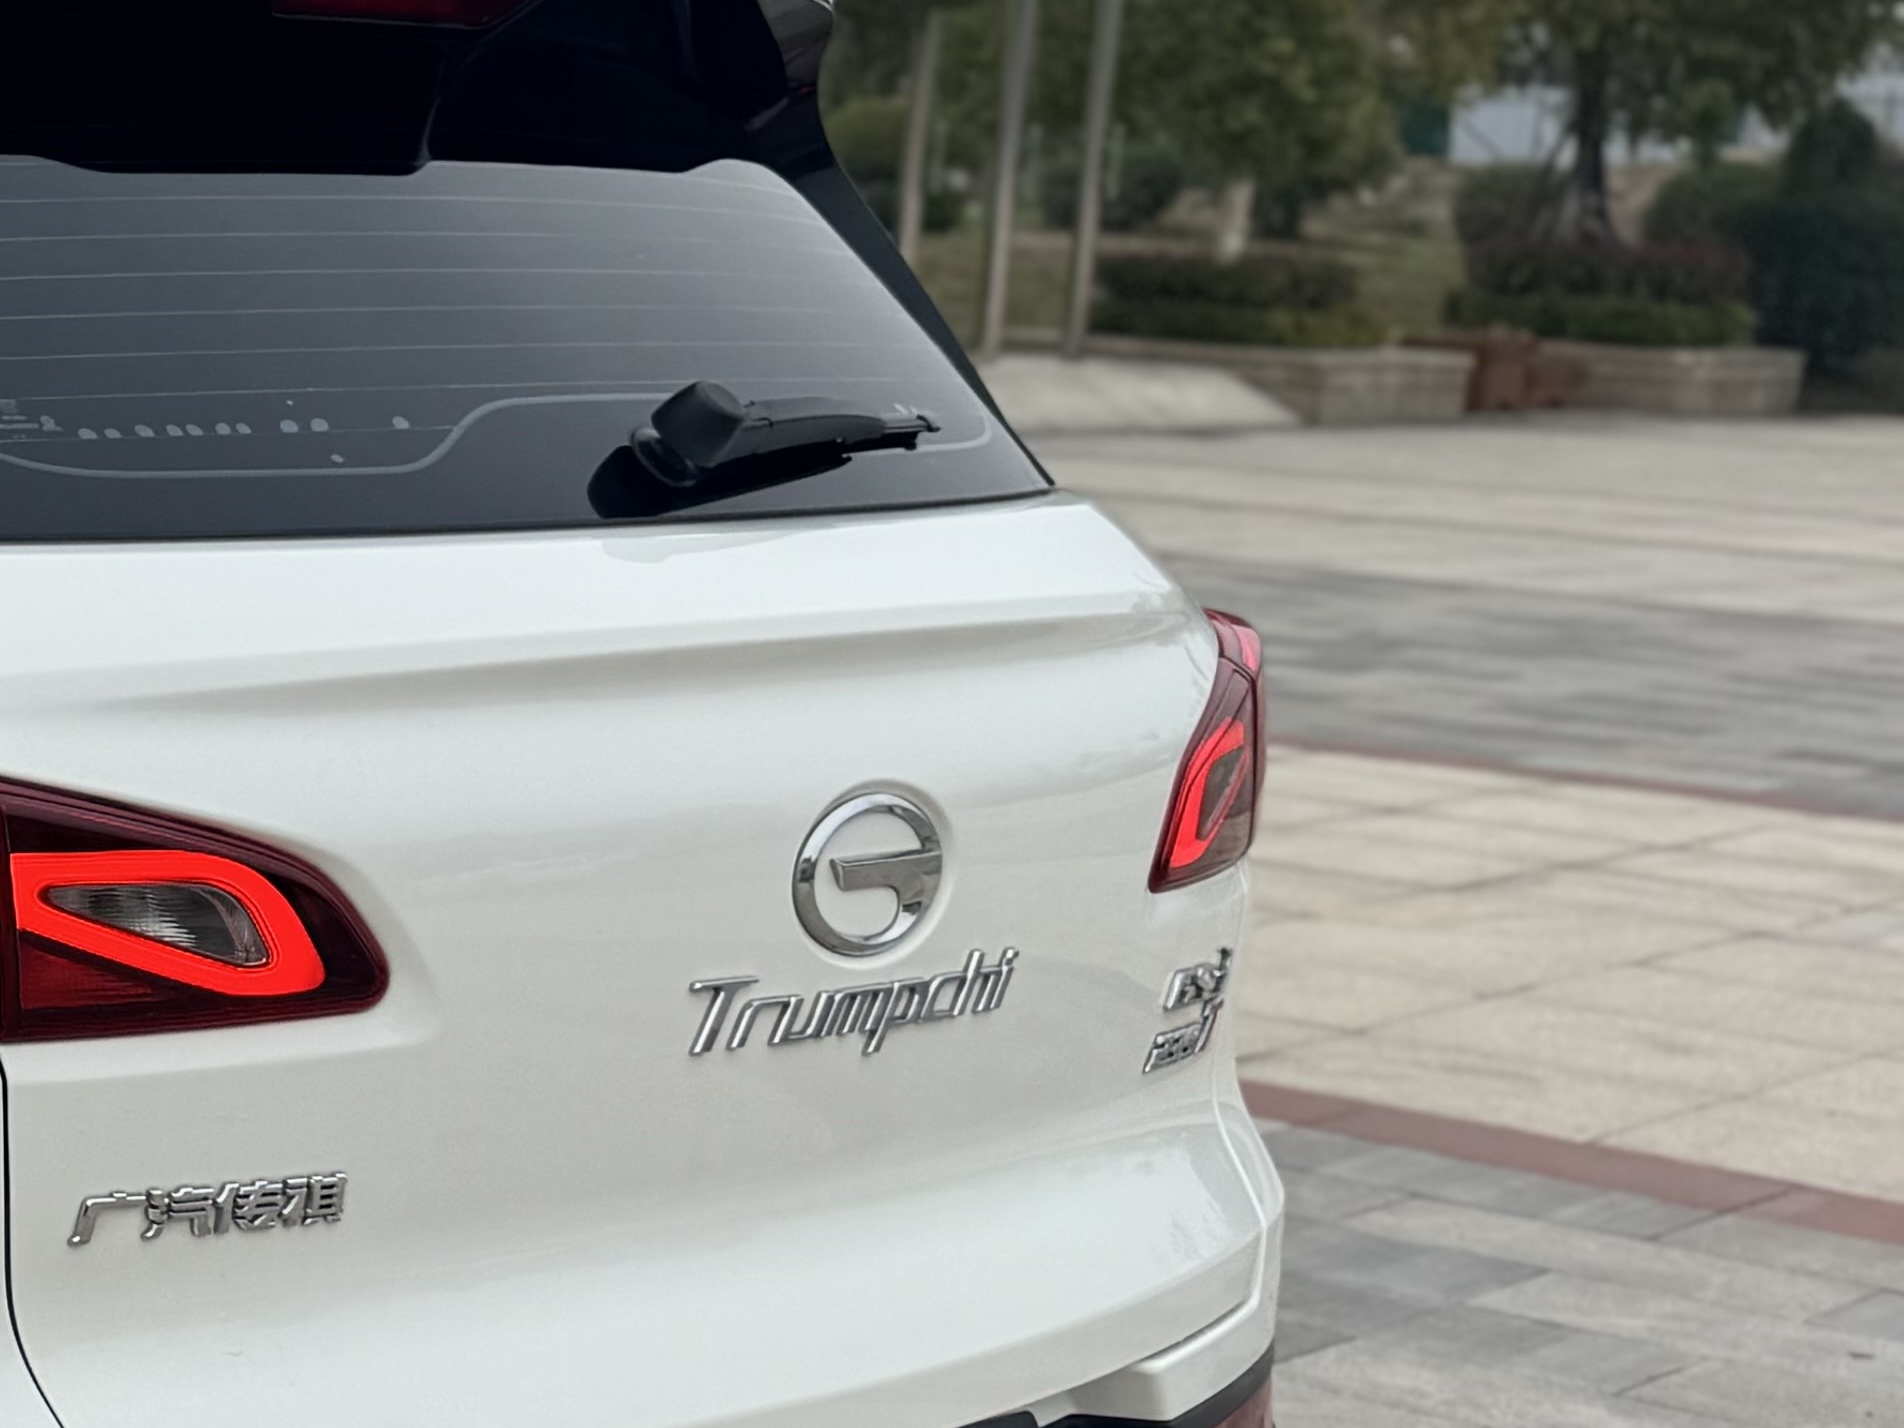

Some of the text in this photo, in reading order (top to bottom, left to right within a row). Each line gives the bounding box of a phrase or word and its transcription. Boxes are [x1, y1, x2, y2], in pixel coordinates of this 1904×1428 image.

[688, 946, 1020, 1056] Trumpchi
[67, 1171, 348, 1247] 广汽传祺
